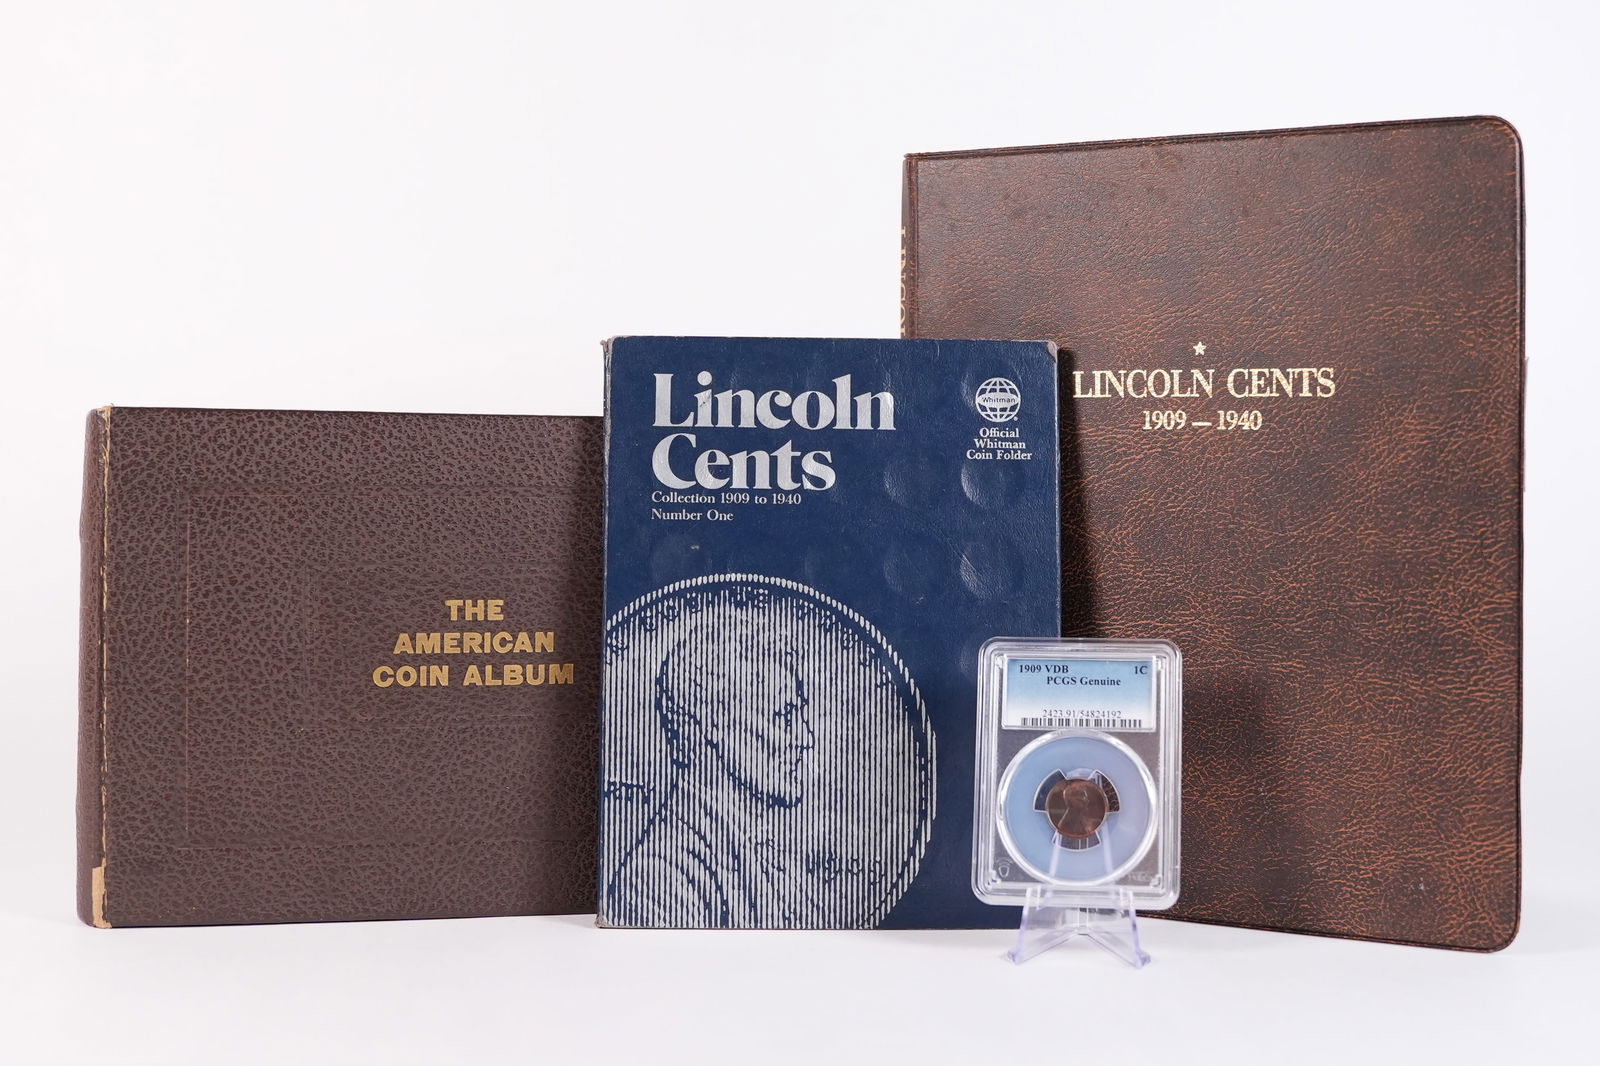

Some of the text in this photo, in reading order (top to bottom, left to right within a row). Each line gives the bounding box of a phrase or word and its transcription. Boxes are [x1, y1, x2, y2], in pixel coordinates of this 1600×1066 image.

[1072, 367, 1335, 398] LINCOLN CENTS
[652, 371, 896, 430] Lincoln
[1142, 410, 1187, 430] 1909
[1217, 410, 1262, 430] 1940
[979, 427, 1019, 438] Official
[973, 438, 1026, 449] Whitman
[652, 433, 836, 491] Cents
[966, 449, 1032, 460] Coin Folder
[651, 491, 802, 505] Collection 1909 to 1940
[651, 508, 734, 521] Number One
[445, 600, 504, 621] THE
[393, 631, 554, 654] AMERICAN
[372, 663, 574, 688] COIN ALBUM
[1018, 664, 1148, 675] 1909 VDB 1C
[1046, 676, 1121, 686] PCGS Genuine
